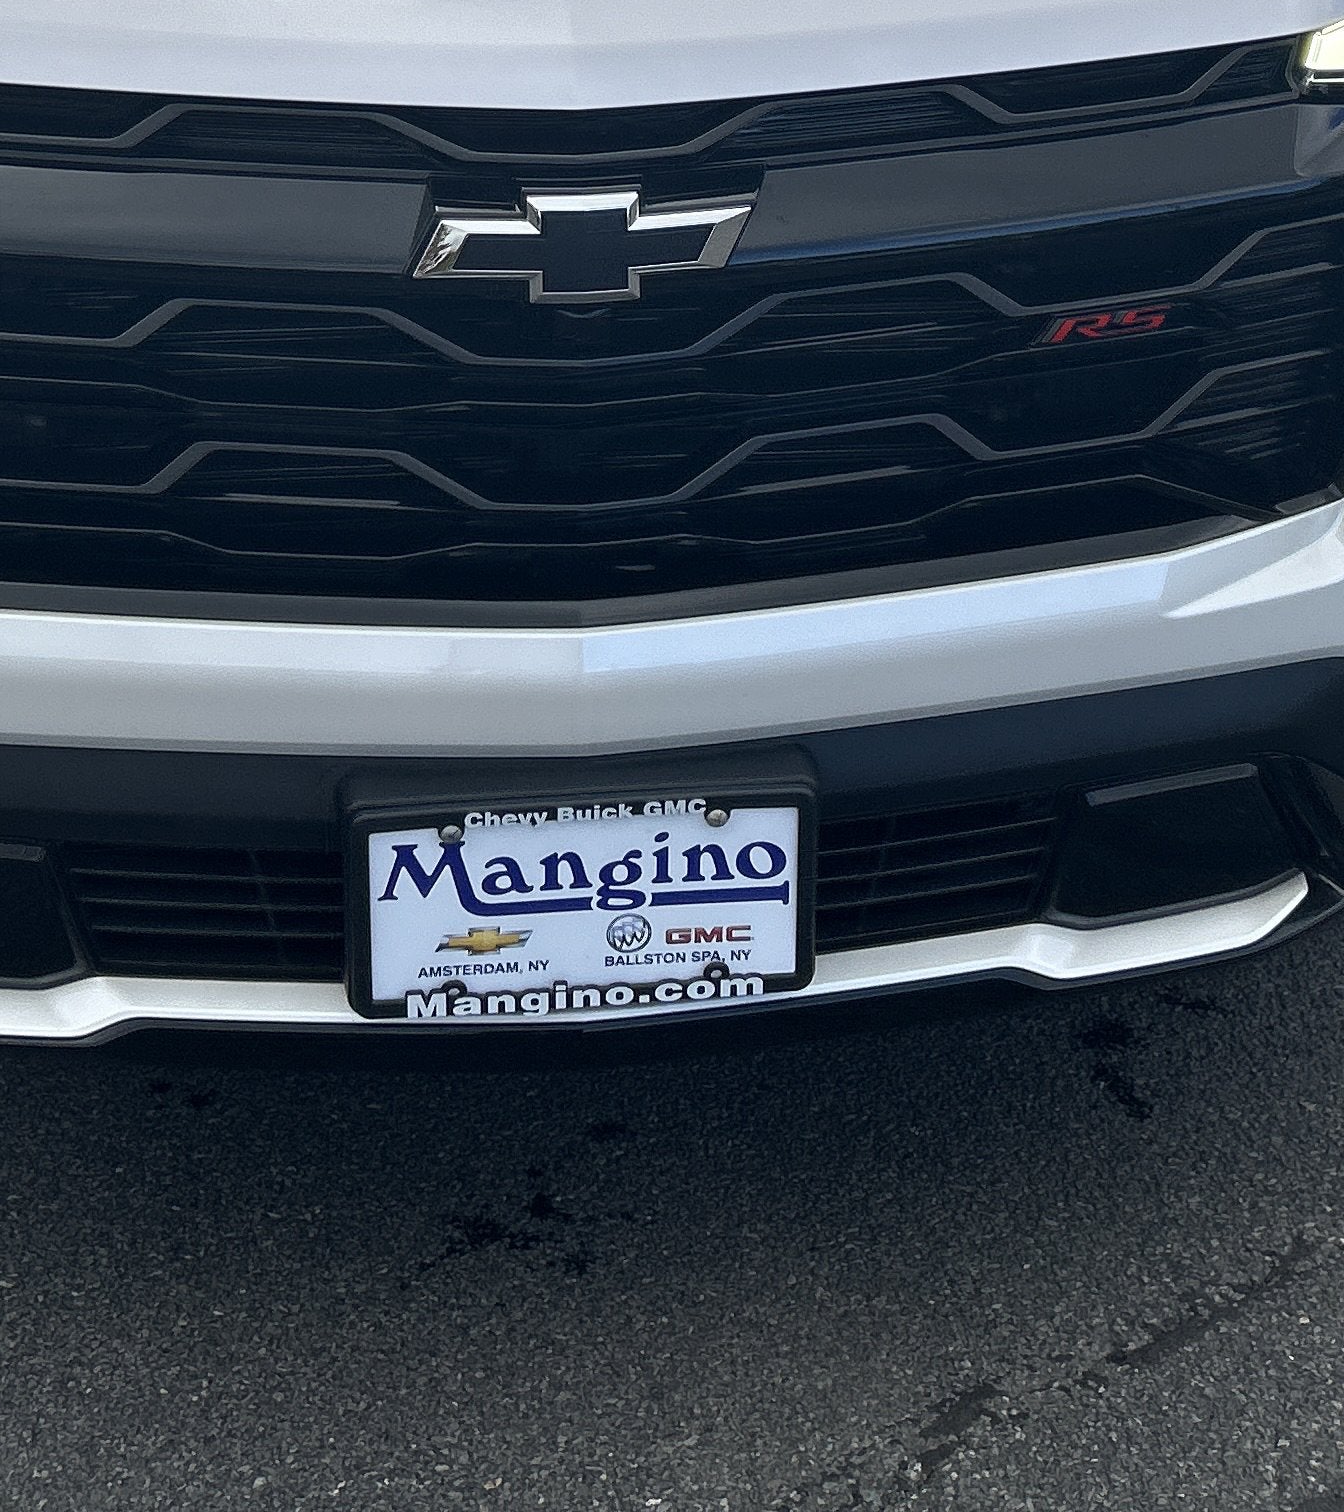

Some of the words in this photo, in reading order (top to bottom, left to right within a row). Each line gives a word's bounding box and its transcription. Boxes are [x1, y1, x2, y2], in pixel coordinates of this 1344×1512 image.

[1042, 302, 1173, 344] RS
[464, 811, 548, 828] Chevy
[556, 804, 633, 822] Buick
[643, 798, 707, 816] GMC
[378, 831, 788, 915] Mangino
[665, 924, 752, 945] GMC
[418, 961, 524, 978] AMSTERDAM,
[528, 959, 550, 972] NY
[605, 951, 687, 967] BALLSTON
[691, 950, 726, 963] SPA,
[730, 949, 752, 961] NY
[407, 976, 764, 1018] Mangino.com
